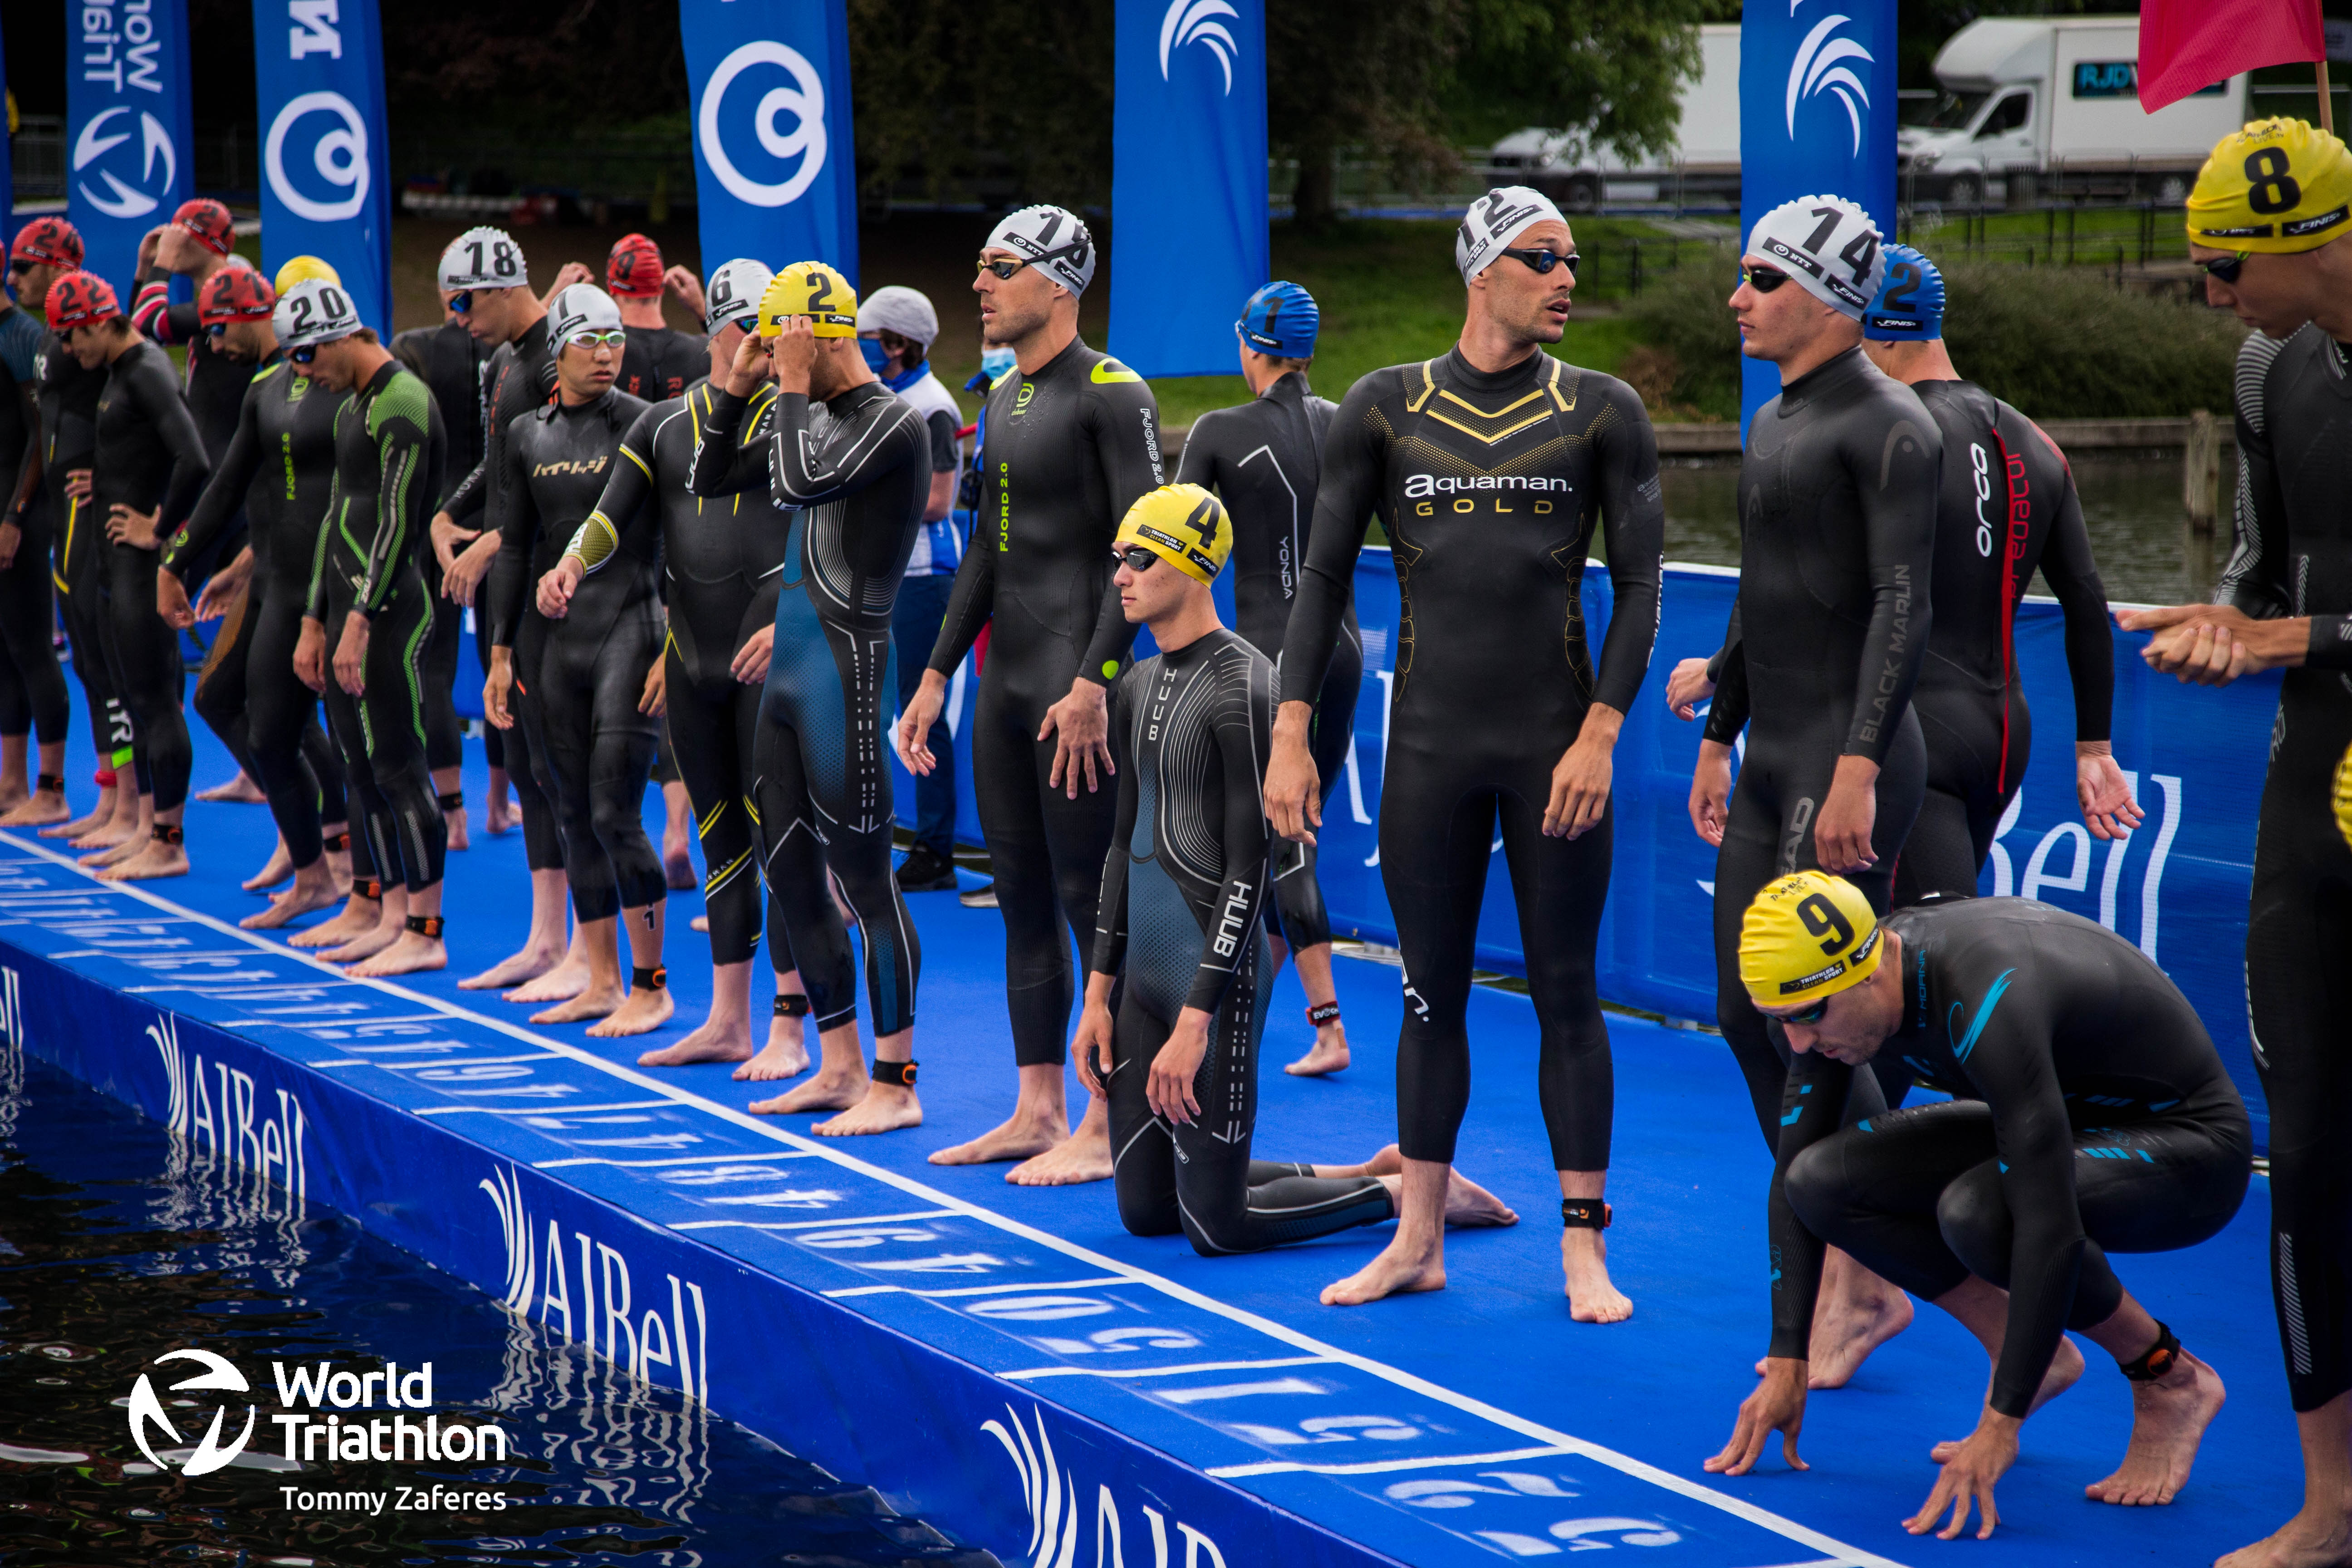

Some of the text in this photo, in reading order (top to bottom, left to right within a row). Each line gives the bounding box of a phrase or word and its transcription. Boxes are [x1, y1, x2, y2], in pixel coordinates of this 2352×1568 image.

[2244, 147, 2302, 215] 8
[1502, 208, 1533, 227] FINIS
[2300, 214, 2338, 230] FINIS
[34, 223, 79, 257] 24
[465, 241, 516, 277] 18
[1027, 244, 1044, 256] NTT
[1811, 206, 1879, 288] 14
[1790, 252, 1812, 269] NTT
[57, 278, 107, 313] 22
[212, 273, 265, 304] 21
[807, 272, 836, 312] 2
[1839, 286, 1864, 305] FINIS
[1883, 262, 1922, 313] 2
[291, 288, 346, 333] 20
[834, 315, 853, 323] FINIS
[1883, 318, 1914, 327] FINIS
[1140, 408, 1165, 484] FJORD 2.0
[1000, 462, 1009, 552] FJORD 2.0
[1416, 498, 1553, 516] GOLD
[1970, 443, 1992, 557] orca
[1149, 534, 1182, 551] CLEAN SPORT
[1151, 529, 1177, 544] TRIATHLON
[1185, 497, 1220, 550] 4
[1199, 556, 1218, 572] FINIS
[1279, 536, 1294, 600] YONDA
[1860, 565, 1911, 744] BLACK MARLIN
[1149, 668, 1178, 741] HUUB
[1213, 880, 1253, 958] HUUB
[1797, 893, 1855, 956] 9
[1861, 928, 1879, 954] FINIS
[1801, 966, 1834, 985] TRIATHLON
[1824, 967, 1843, 981] SPORT
[1918, 949, 1927, 1010] MOANA
[657, 1165, 843, 1209] 48
[542, 1219, 707, 1408] AJBell
[965, 1295, 1203, 1353] 50
